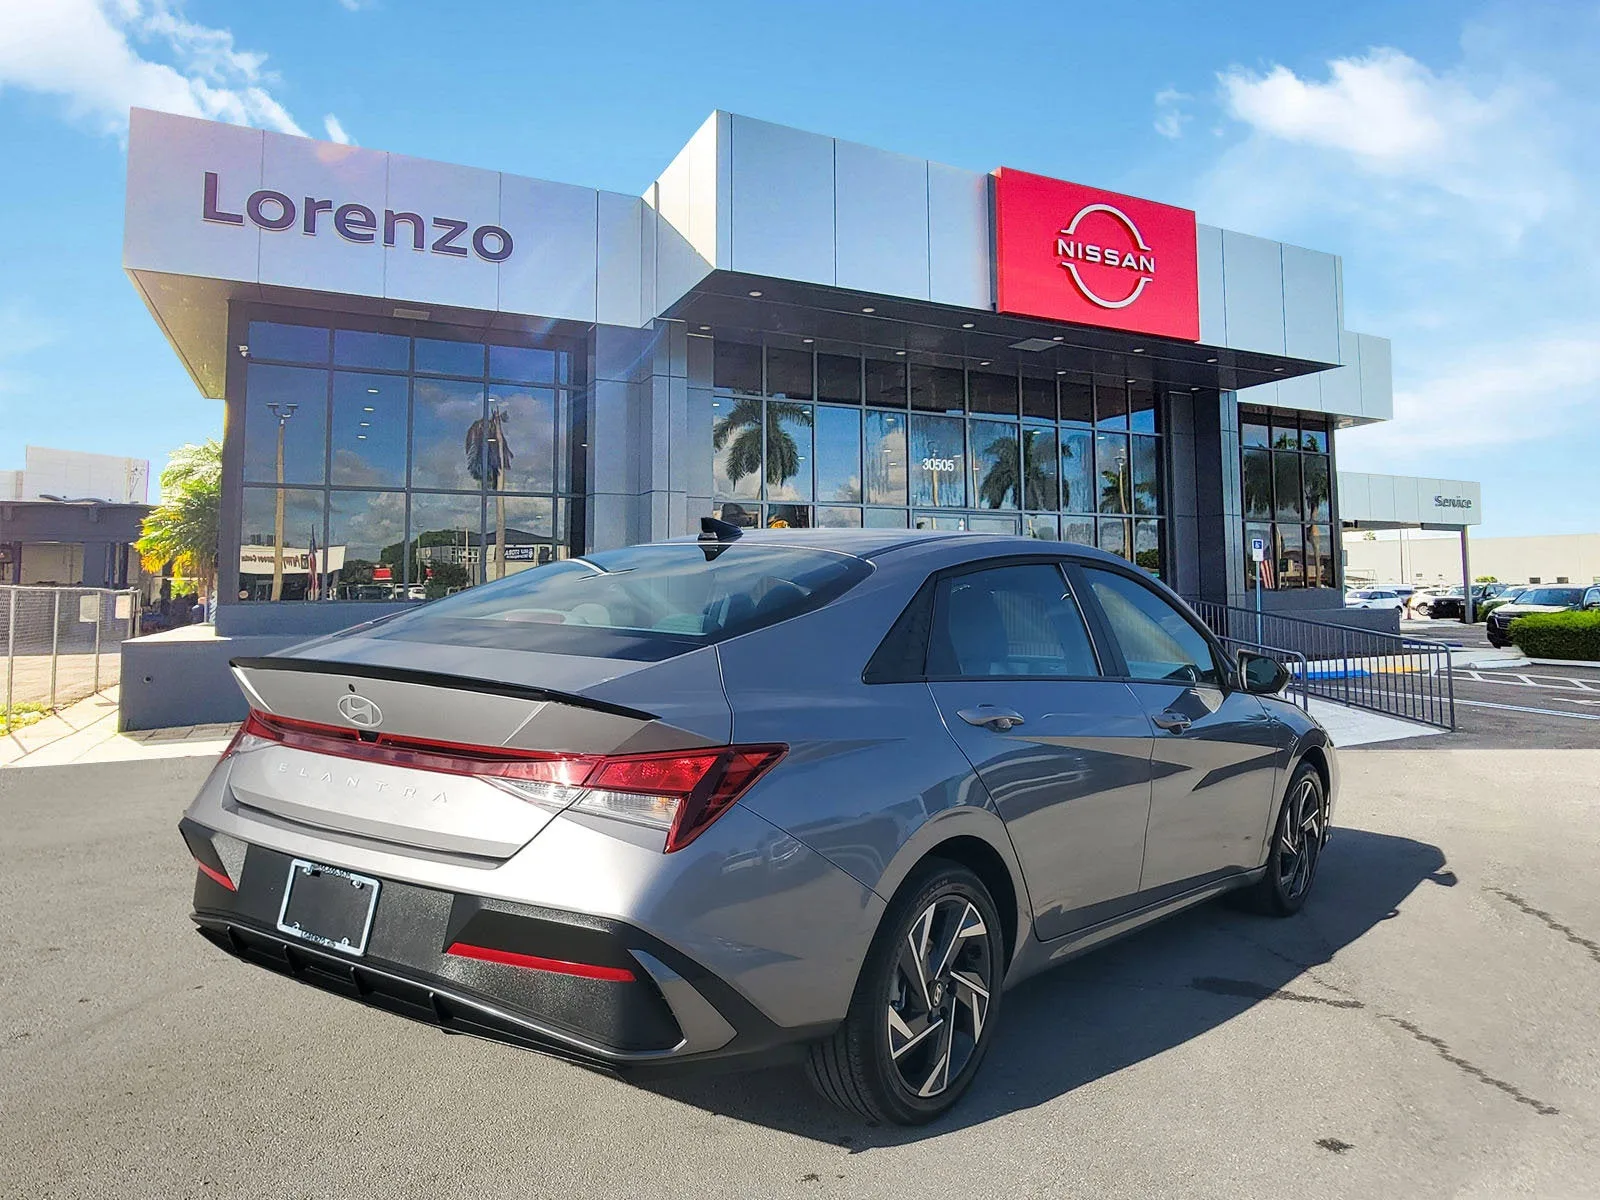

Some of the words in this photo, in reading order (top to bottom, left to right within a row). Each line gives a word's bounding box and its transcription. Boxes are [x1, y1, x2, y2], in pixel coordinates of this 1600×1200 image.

[202, 171, 515, 263] Lorenzo
[1057, 238, 1155, 273] NISSAN
[922, 458, 955, 472] 30505
[1434, 495, 1472, 509] Service
[278, 762, 449, 803] ELANTRA
